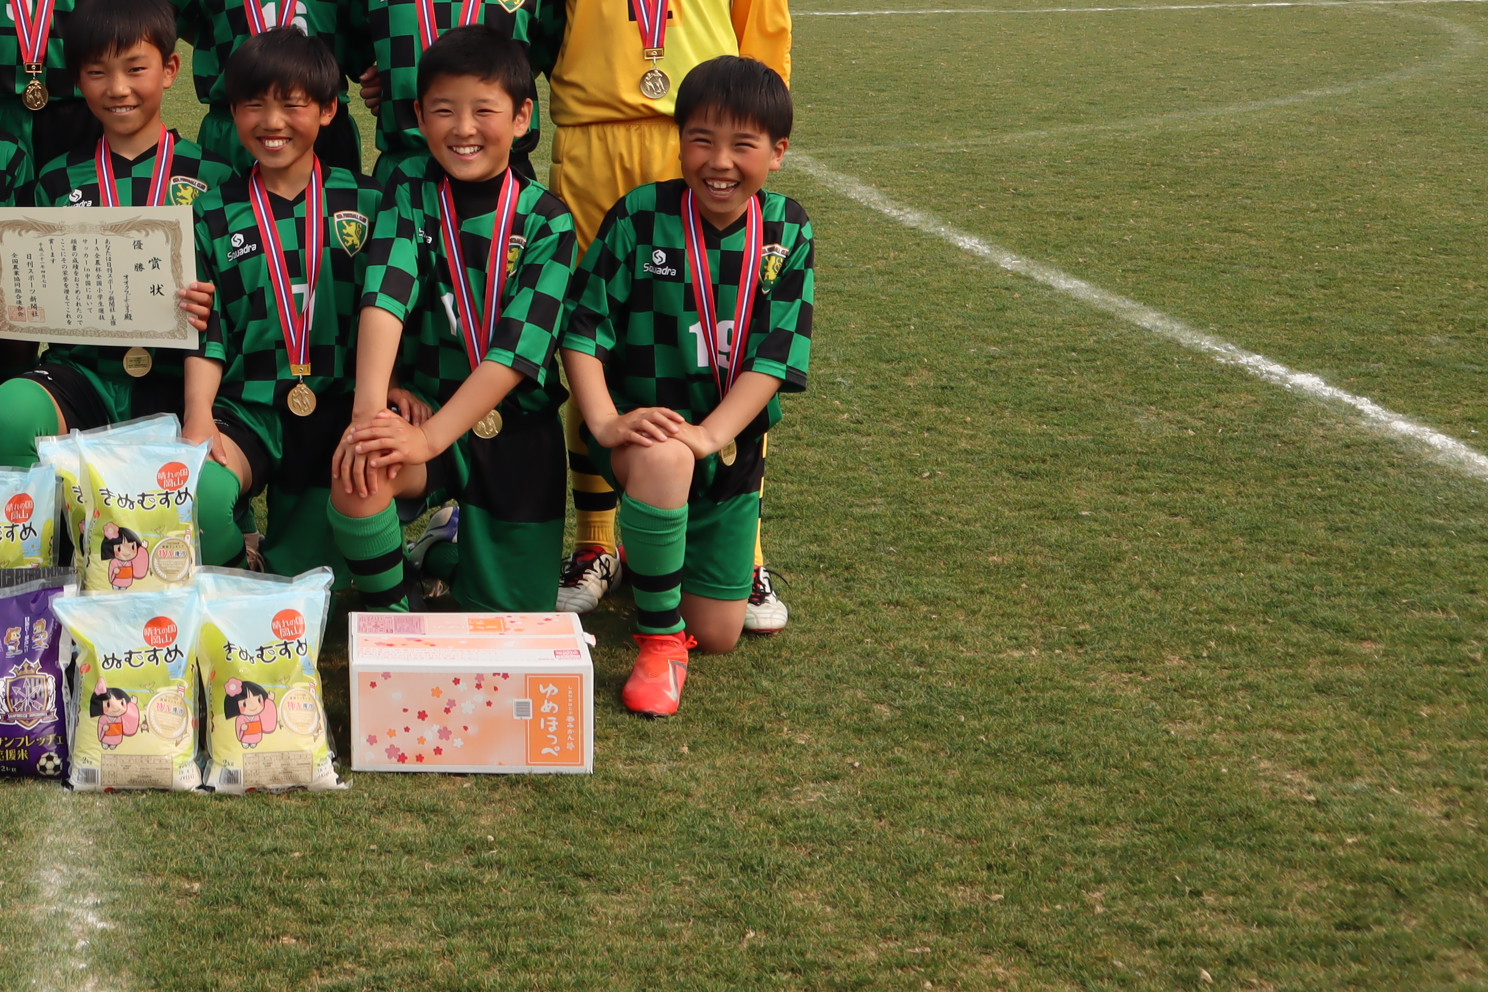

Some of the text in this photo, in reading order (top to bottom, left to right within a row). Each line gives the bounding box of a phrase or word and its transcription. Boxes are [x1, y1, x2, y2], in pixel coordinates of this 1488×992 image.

[227, 243, 257, 261] Squadra
[643, 262, 677, 276] Squadra
[689, 320, 735, 369] 19
[163, 478, 184, 488] 岡山
[99, 486, 194, 511] きぬむすめ
[150, 634, 173, 645] 岡山
[280, 627, 302, 639] 岡山
[101, 643, 185, 670] ぬむすめ
[223, 639, 308, 665] きぬむすめ
[539, 683, 561, 757] ゆめほっぺ
